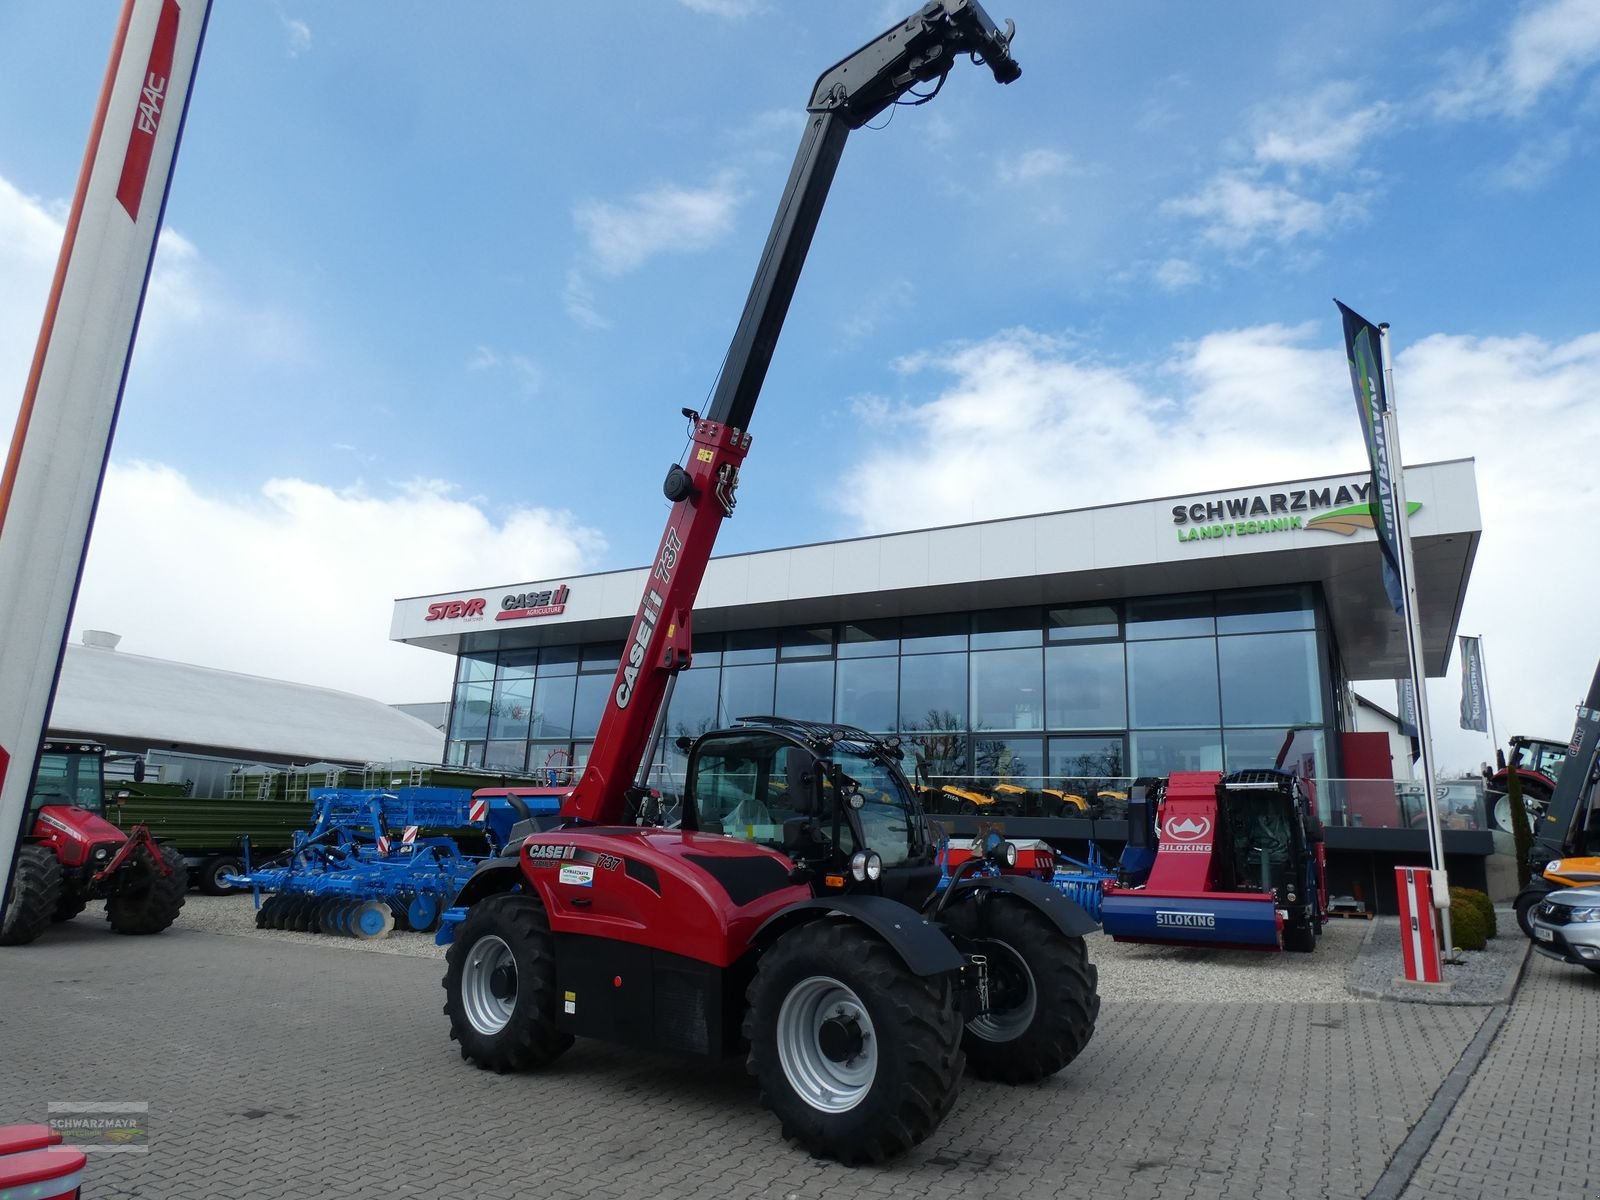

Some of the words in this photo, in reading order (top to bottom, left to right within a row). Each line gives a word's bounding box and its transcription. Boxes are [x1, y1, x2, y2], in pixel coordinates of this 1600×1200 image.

[138, 72, 166, 135] FAAC
[1172, 483, 1371, 524] SCHWARZMAY
[1178, 515, 1303, 542] LANDTECHNIK
[425, 598, 487, 621] STEYR
[501, 591, 552, 610] CASE
[526, 606, 561, 616] AGRICULTURE
[615, 623, 652, 708] CASE
[654, 526, 682, 584] 737
[529, 845, 563, 859] CASE
[598, 854, 622, 870] 737
[1158, 844, 1212, 852] SILOKING
[1156, 914, 1215, 926] SILOKING
